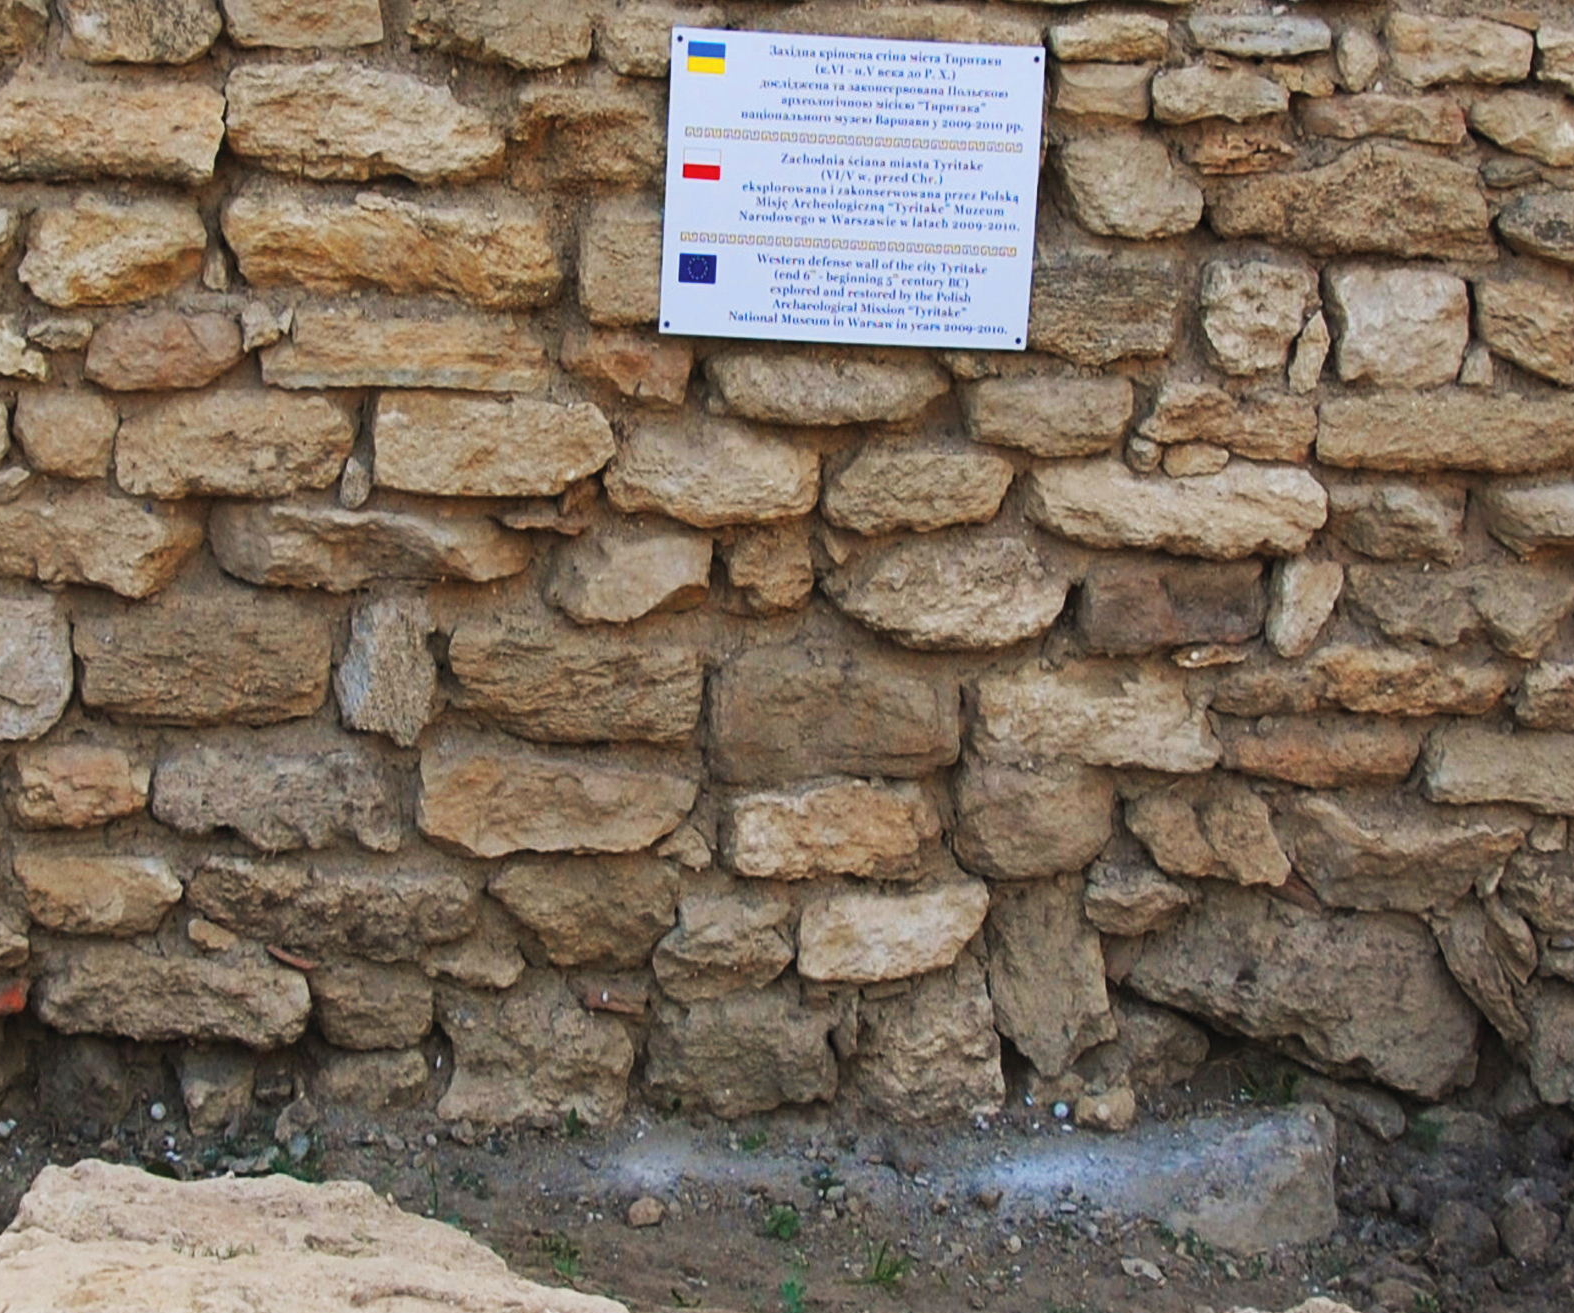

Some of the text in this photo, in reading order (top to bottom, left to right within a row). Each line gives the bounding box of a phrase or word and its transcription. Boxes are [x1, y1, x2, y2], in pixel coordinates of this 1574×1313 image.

[781, 153, 983, 172] Zachodnia ściana miasta Tyritake
[742, 180, 1019, 204] eksplorowana i zakonserwowana przez Polską
[756, 196, 788, 210] Misję
[792, 198, 884, 213] Archeologiczną
[954, 205, 1004, 216] Muzeum
[739, 210, 815, 225] Narodowego
[832, 214, 896, 227] Warszawie
[913, 217, 948, 229] latach
[757, 253, 988, 275] Western defense wall of the city Tyritake
[774, 269, 800, 281] (end
[827, 271, 883, 286] beginning
[901, 278, 943, 289] century
[949, 278, 969, 289] BC)
[770, 284, 971, 303] explored and restored by the Polish
[772, 299, 857, 314] Archaeological
[860, 303, 905, 315] Mission
[729, 310, 777, 323] National
[781, 313, 830, 326] Museum
[833, 316, 844, 327] in
[848, 317, 892, 329] Warsaw
[896, 318, 907, 330] in
[911, 324, 940, 333] years
